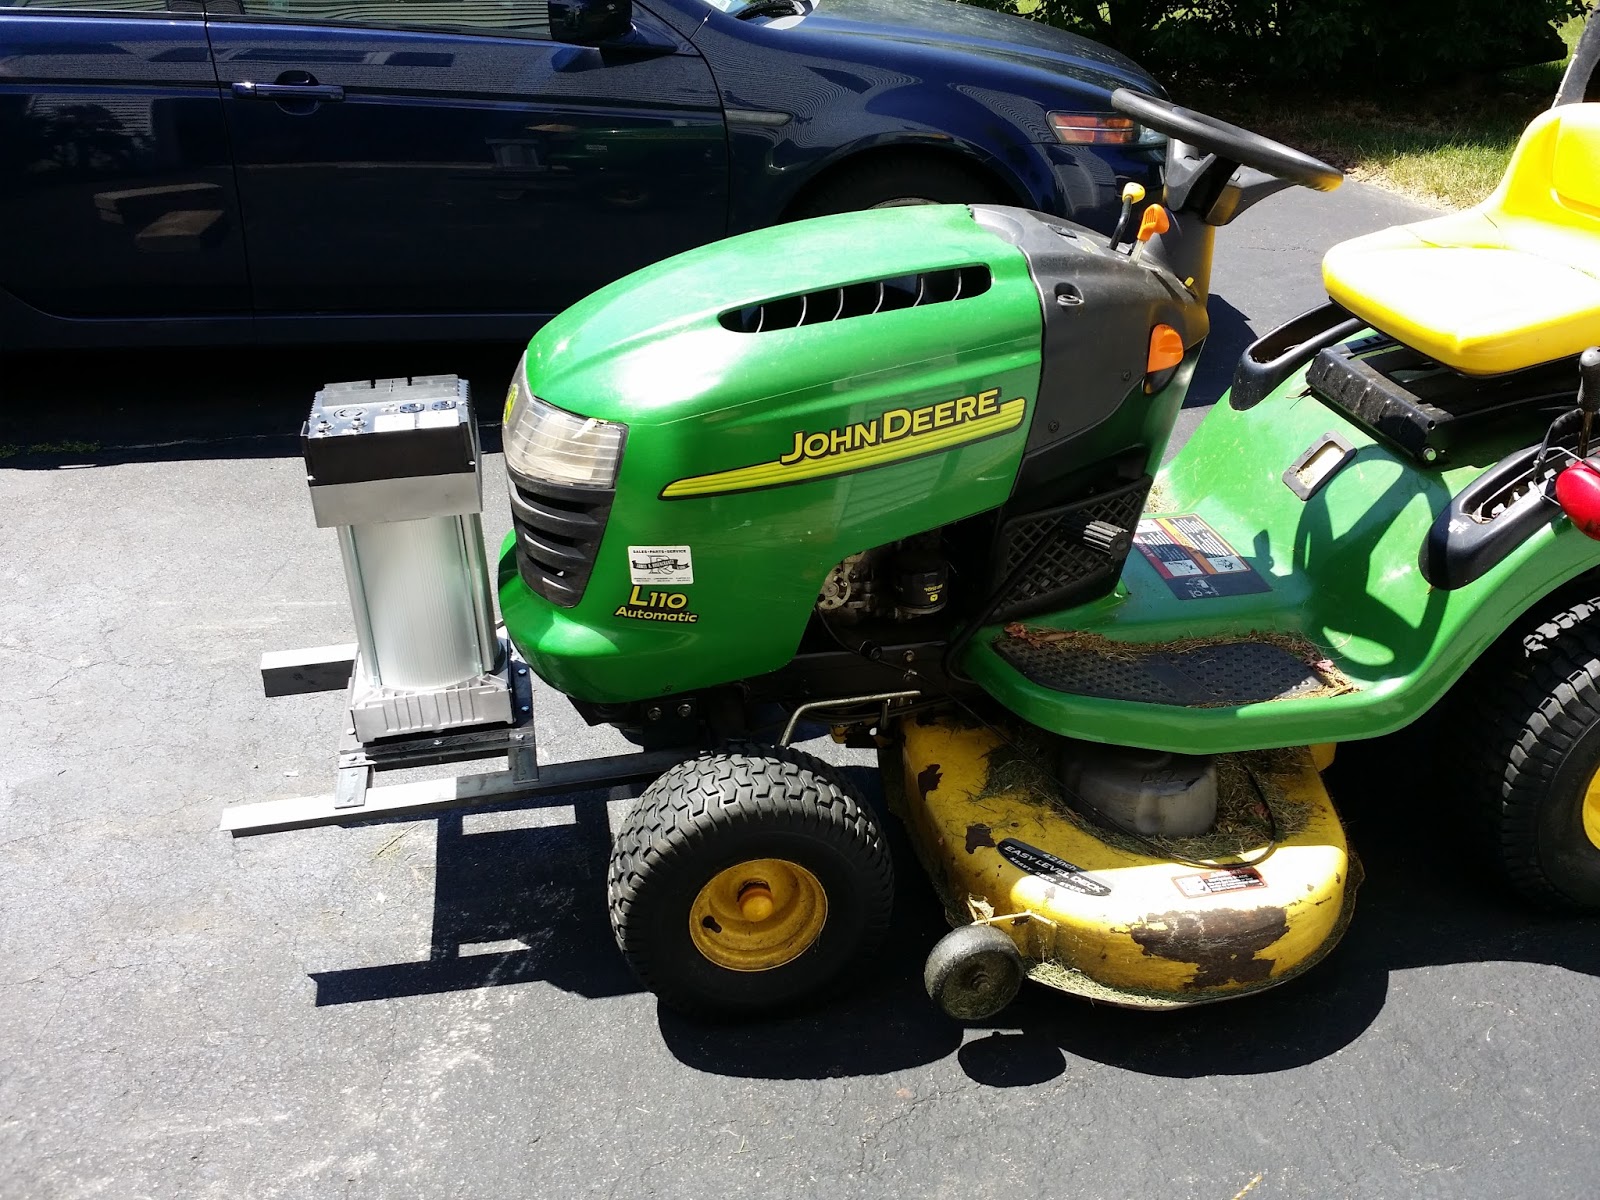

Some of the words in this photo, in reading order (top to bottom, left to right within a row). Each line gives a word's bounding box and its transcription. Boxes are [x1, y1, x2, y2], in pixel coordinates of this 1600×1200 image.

[780, 419, 878, 464] JOHN
[882, 387, 999, 440] DEERE
[628, 585, 687, 609] L110
[614, 606, 698, 623] Automatic
[1004, 845, 1037, 861] EASY
[1035, 859, 1069, 879] LEVEL
[1070, 875, 1105, 893] DECK
[1057, 859, 1077, 871] inch
